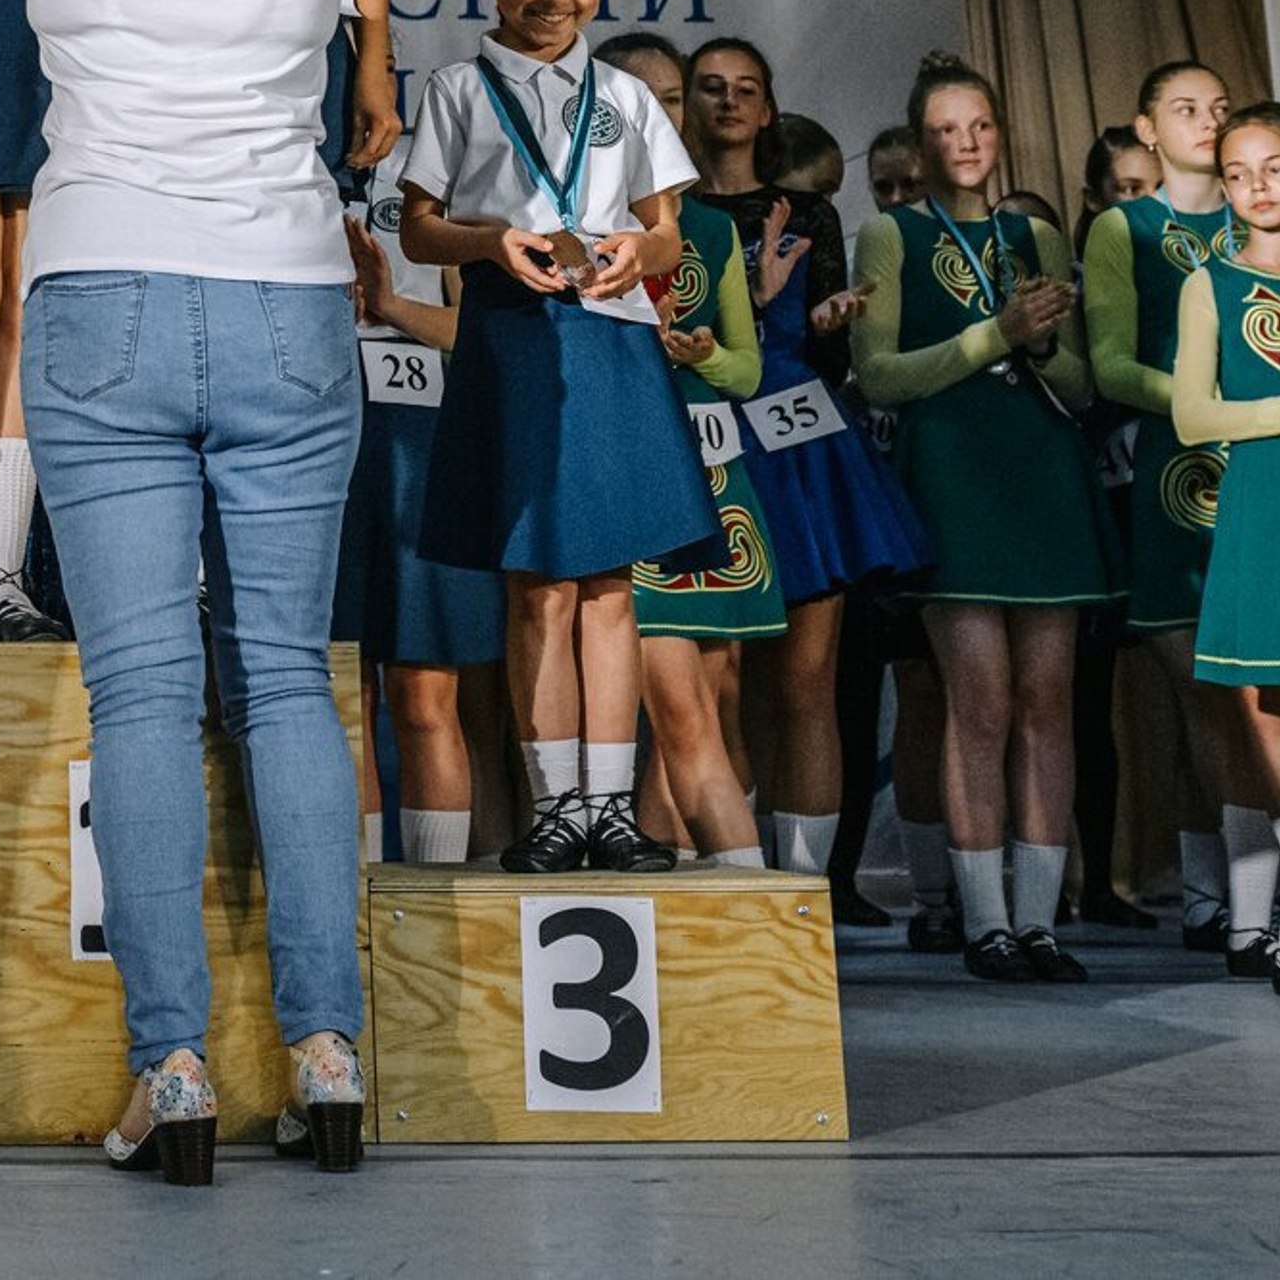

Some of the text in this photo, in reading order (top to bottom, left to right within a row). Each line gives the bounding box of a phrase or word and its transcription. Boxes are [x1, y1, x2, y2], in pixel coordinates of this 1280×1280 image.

[381, 353, 427, 392] 28
[767, 395, 820, 437] 35
[539, 907, 650, 1091] 3
